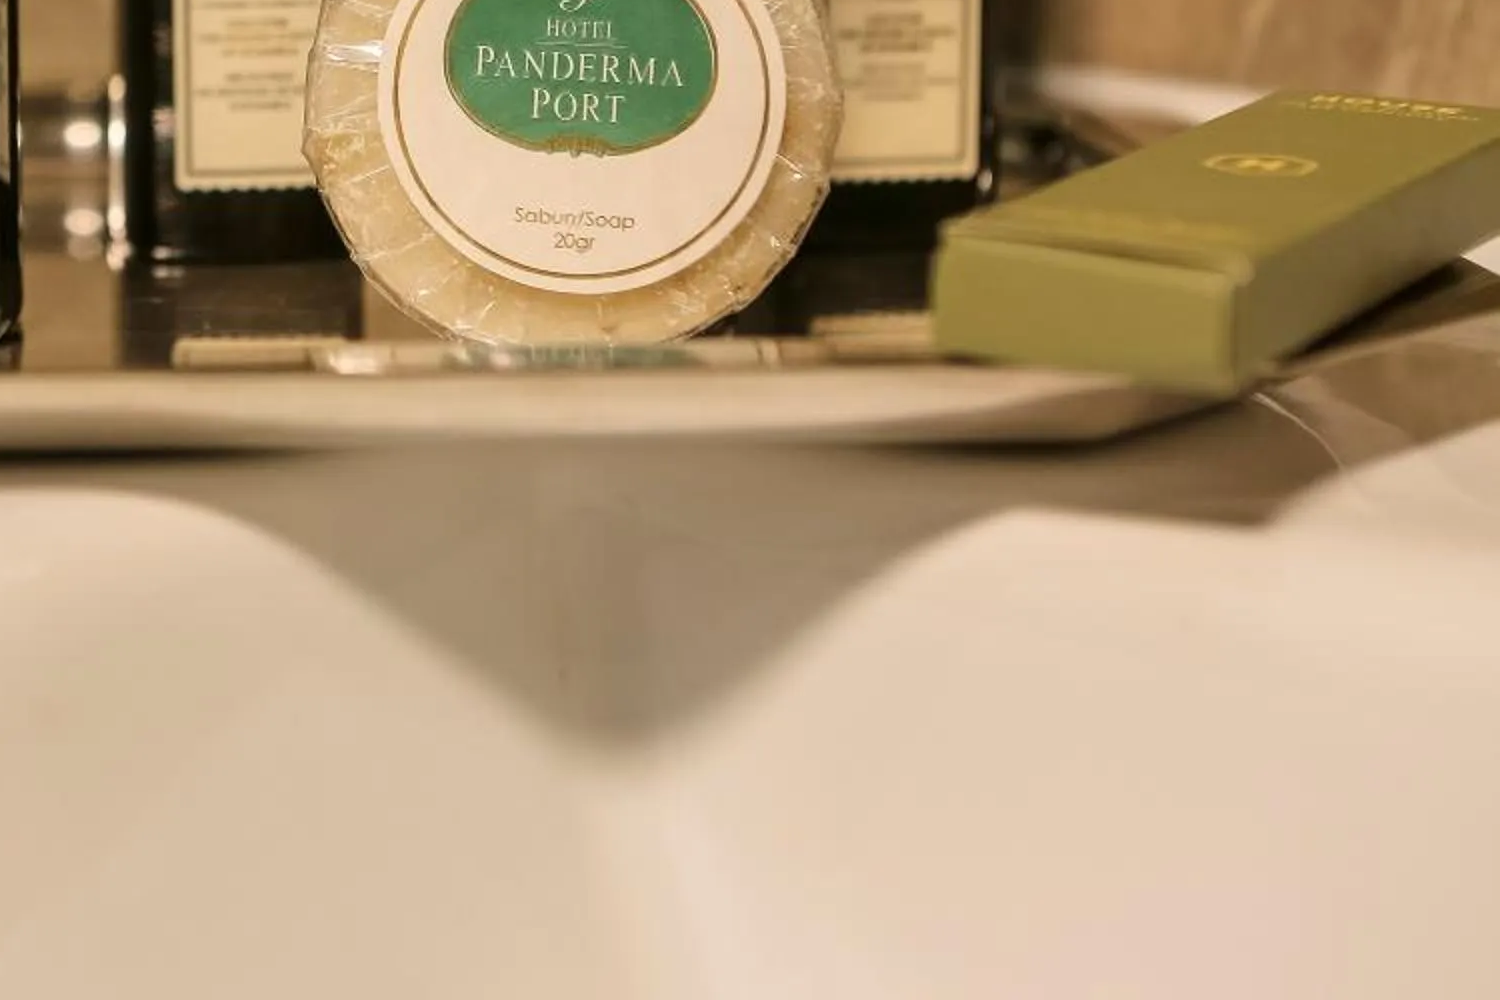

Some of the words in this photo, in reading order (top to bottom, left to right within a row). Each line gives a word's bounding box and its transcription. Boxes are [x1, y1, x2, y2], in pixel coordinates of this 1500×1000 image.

[547, 19, 615, 38] HOTEL
[474, 45, 684, 88] PANDERMA
[531, 87, 626, 123] PORT
[514, 206, 636, 232] Sabun/Soap
[553, 231, 596, 254] 20gr
